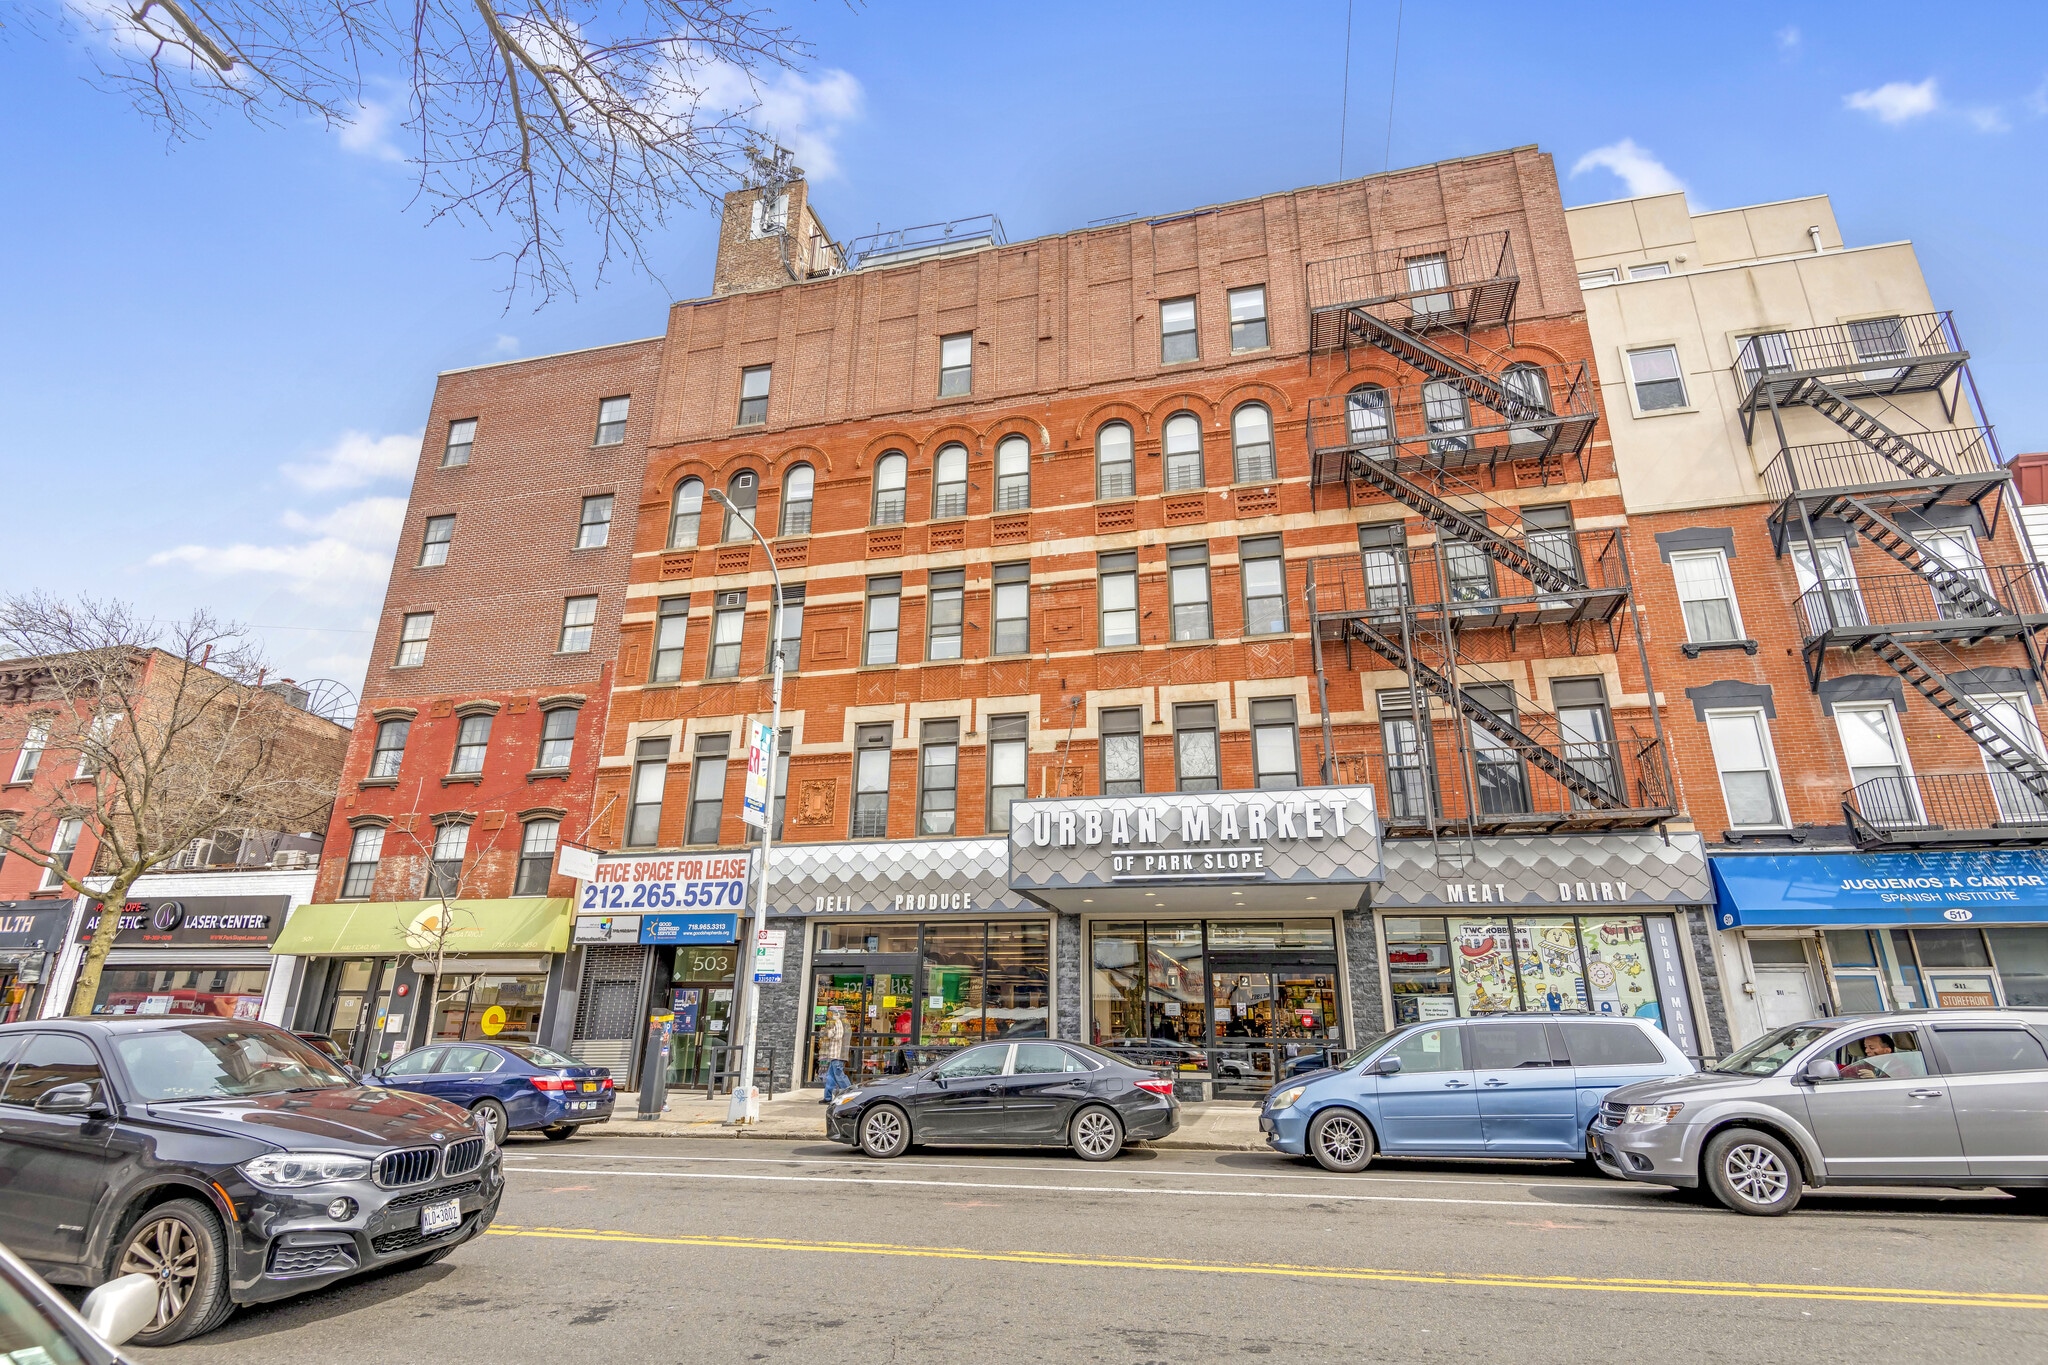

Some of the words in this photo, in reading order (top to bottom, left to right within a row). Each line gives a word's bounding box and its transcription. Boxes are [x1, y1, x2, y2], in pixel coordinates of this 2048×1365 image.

[1033, 807, 1157, 846] URBAN
[1181, 800, 1347, 843] MARKET
[1113, 856, 1135, 872] OF
[1145, 854, 1194, 871] PARK
[1204, 852, 1264, 870] SLOPE
[588, 863, 631, 882] FFICE
[633, 861, 675, 882] SPACE
[676, 860, 703, 881] FOR
[705, 858, 747, 880] LEASE
[1840, 877, 1944, 890] JUGUEMOS
[1949, 877, 1964, 888] A
[1967, 875, 2046, 888] CANTAR
[582, 880, 743, 909] 212.265.5570
[1446, 883, 1506, 903] MEAT
[1559, 881, 1627, 902] DAIRY
[1880, 892, 1943, 903] SPANISH
[1945, 891, 2020, 902] INSTITUTE
[815, 895, 851, 912] DELI
[895, 892, 971, 911] PRODUCE
[184, 914, 217, 929] LASER
[219, 914, 264, 929] CENTER
[1949, 911, 1968, 920] 511
[1657, 923, 1677, 987] URBAN
[692, 956, 728, 971] 503
[1241, 977, 1249, 986] 2
[1317, 977, 1324, 987] 3
[1942, 995, 1990, 1006] STOREFRONT
